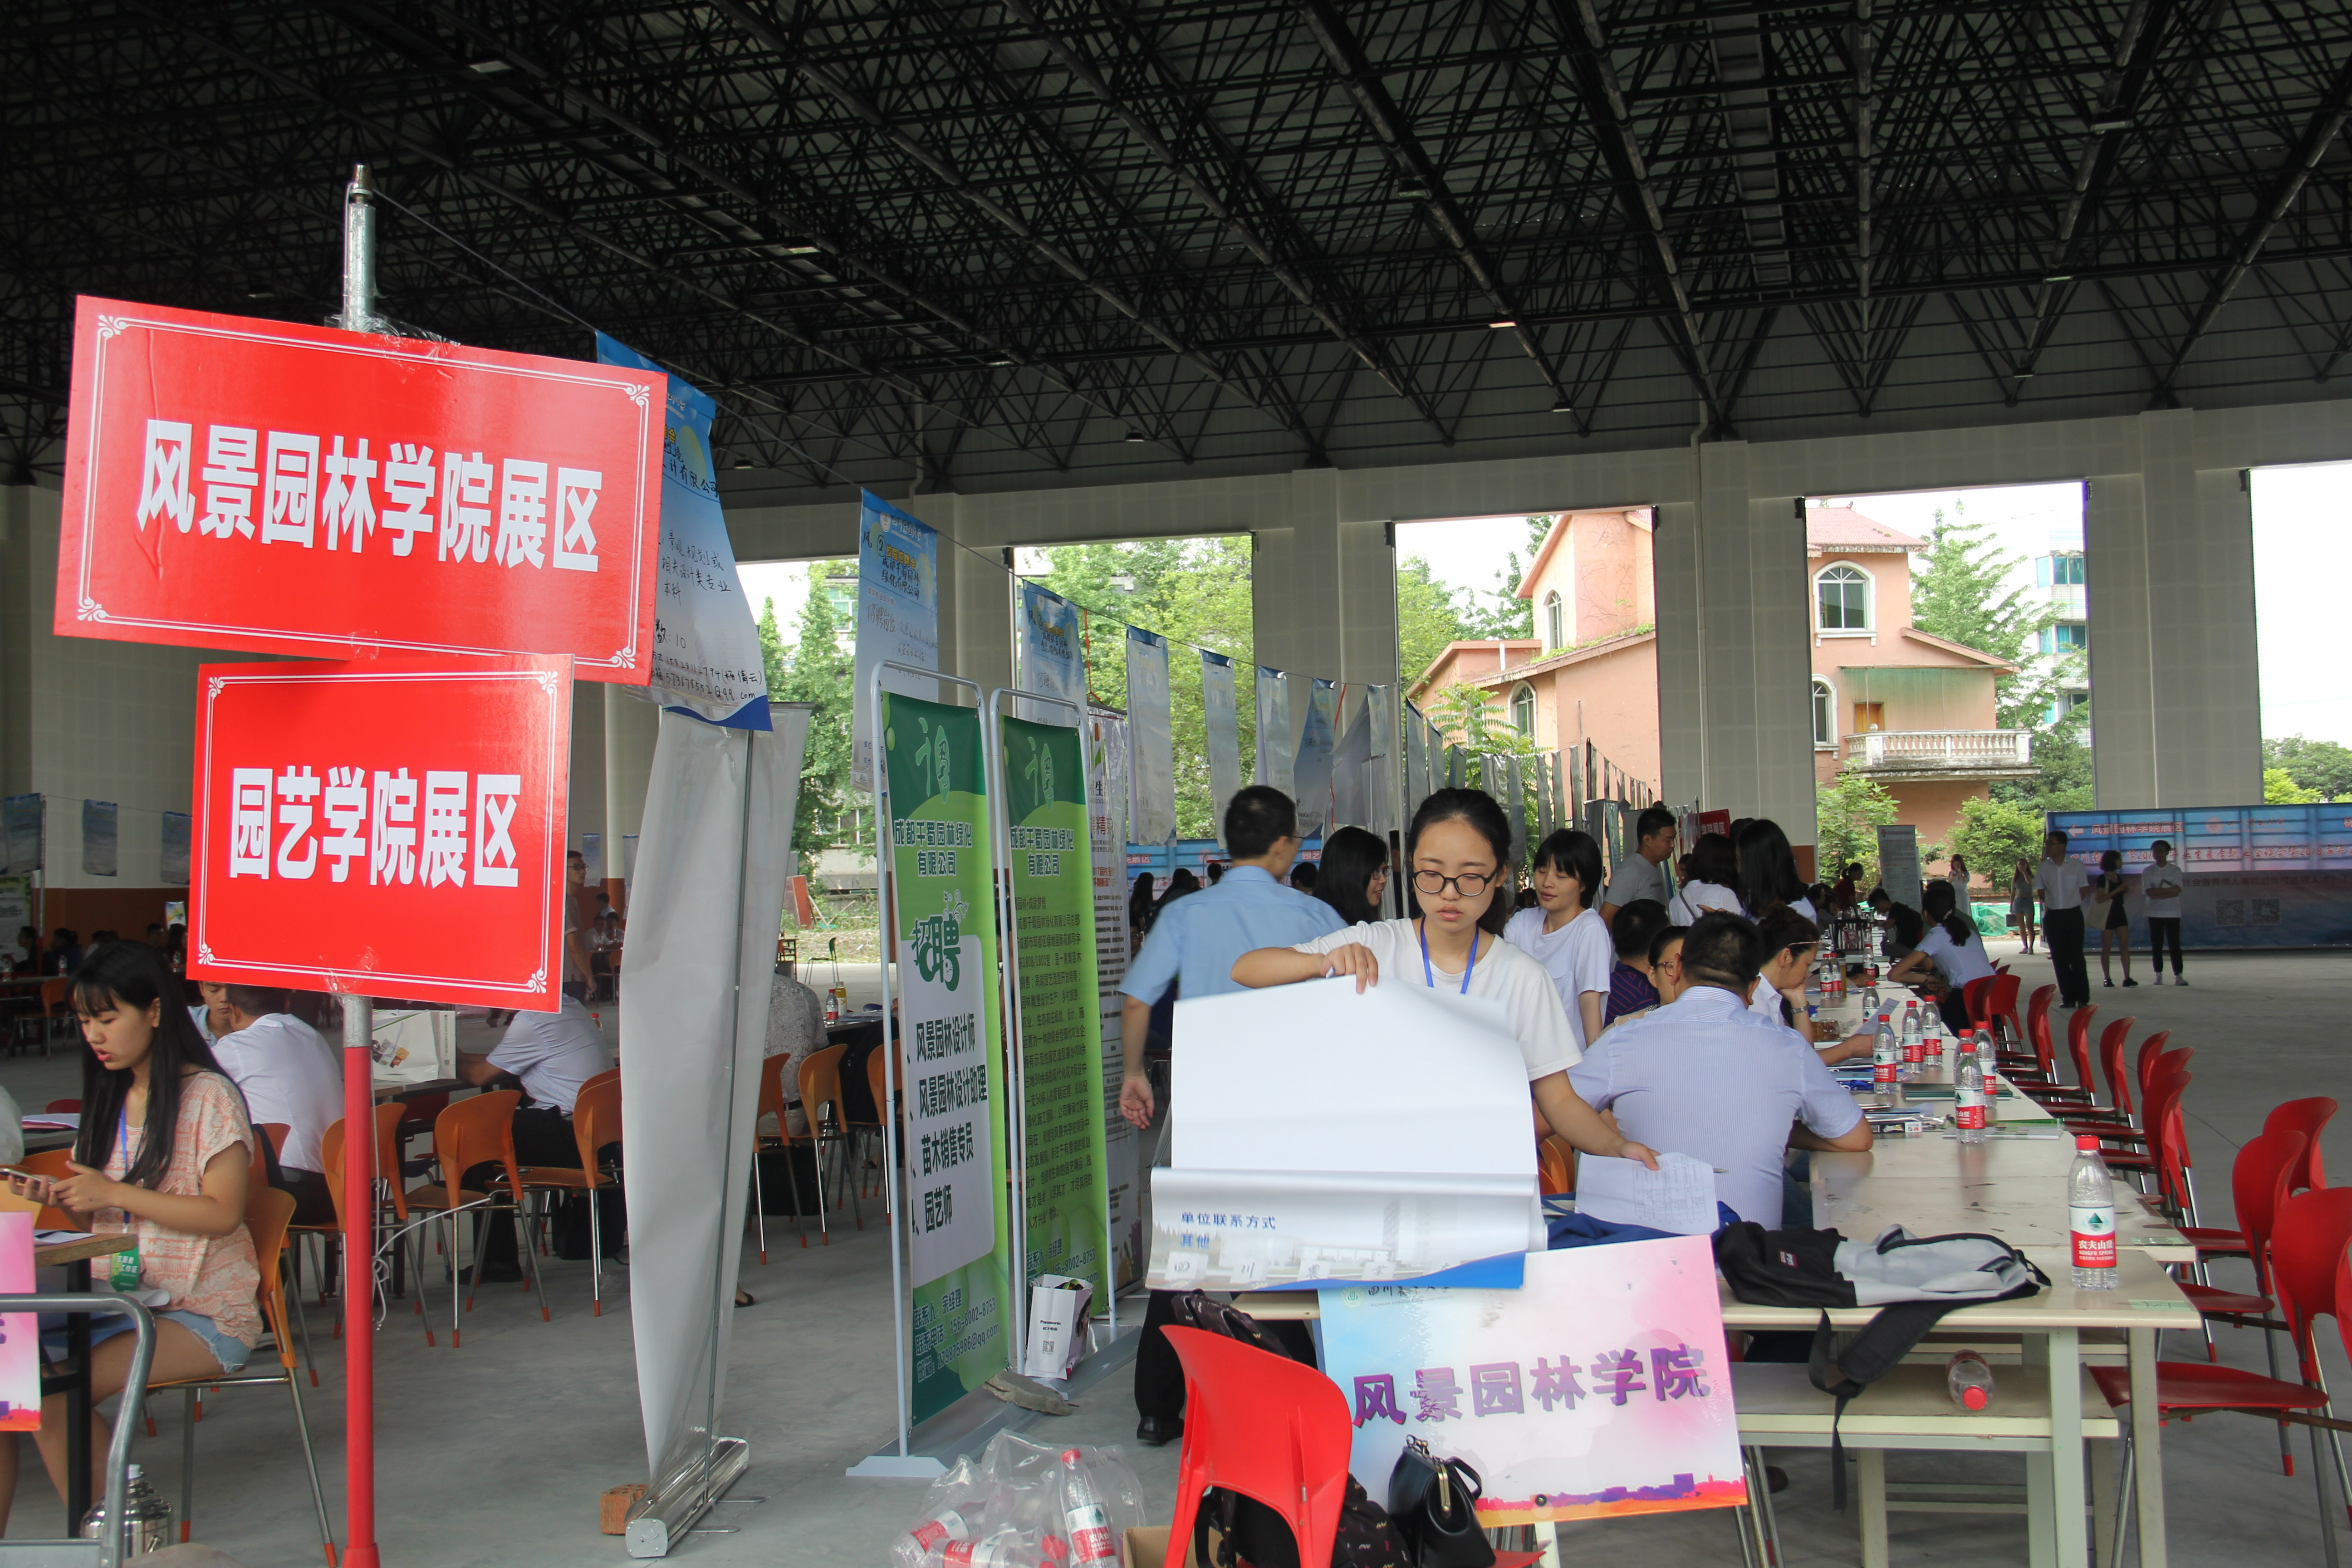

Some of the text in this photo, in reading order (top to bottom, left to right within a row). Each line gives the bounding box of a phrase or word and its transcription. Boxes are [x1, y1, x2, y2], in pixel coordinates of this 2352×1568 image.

[663, 459, 719, 498] 计有限公司
[136, 419, 603, 574] 风景园林学院展区
[886, 544, 916, 570] 校园招聘会
[229, 764, 521, 888] 园艺学院展区
[894, 818, 972, 848] 成都千蜀园林绿化
[1010, 825, 1074, 852] 成都千蜀园林绿化
[2091, 821, 2184, 836] 风景园林学院展区
[917, 849, 956, 877] 有限公司
[1027, 853, 1060, 877] 有限公司
[1302, 850, 1321, 860] 园艺
[909, 912, 961, 992] 招聘
[1017, 932, 1081, 950] 成都市郫都区绿地国际花都写字
[916, 1012, 975, 1063] 风景园林设计师
[919, 1064, 987, 1120] 风景园林设计助理
[921, 1121, 974, 1177] 苗木销售专员
[924, 1184, 952, 1234] 园艺师
[1180, 1211, 1276, 1230] 单位联系方式
[1180, 1233, 1210, 1250] 其他
[2078, 1239, 2113, 1250] 农夫山泉
[941, 1288, 962, 1315] 余经理
[950, 1296, 996, 1336] 156-8002-8753
[937, 1323, 1000, 1370] 279875986@qq.com
[1352, 1343, 1712, 1430] 风景园林学院
